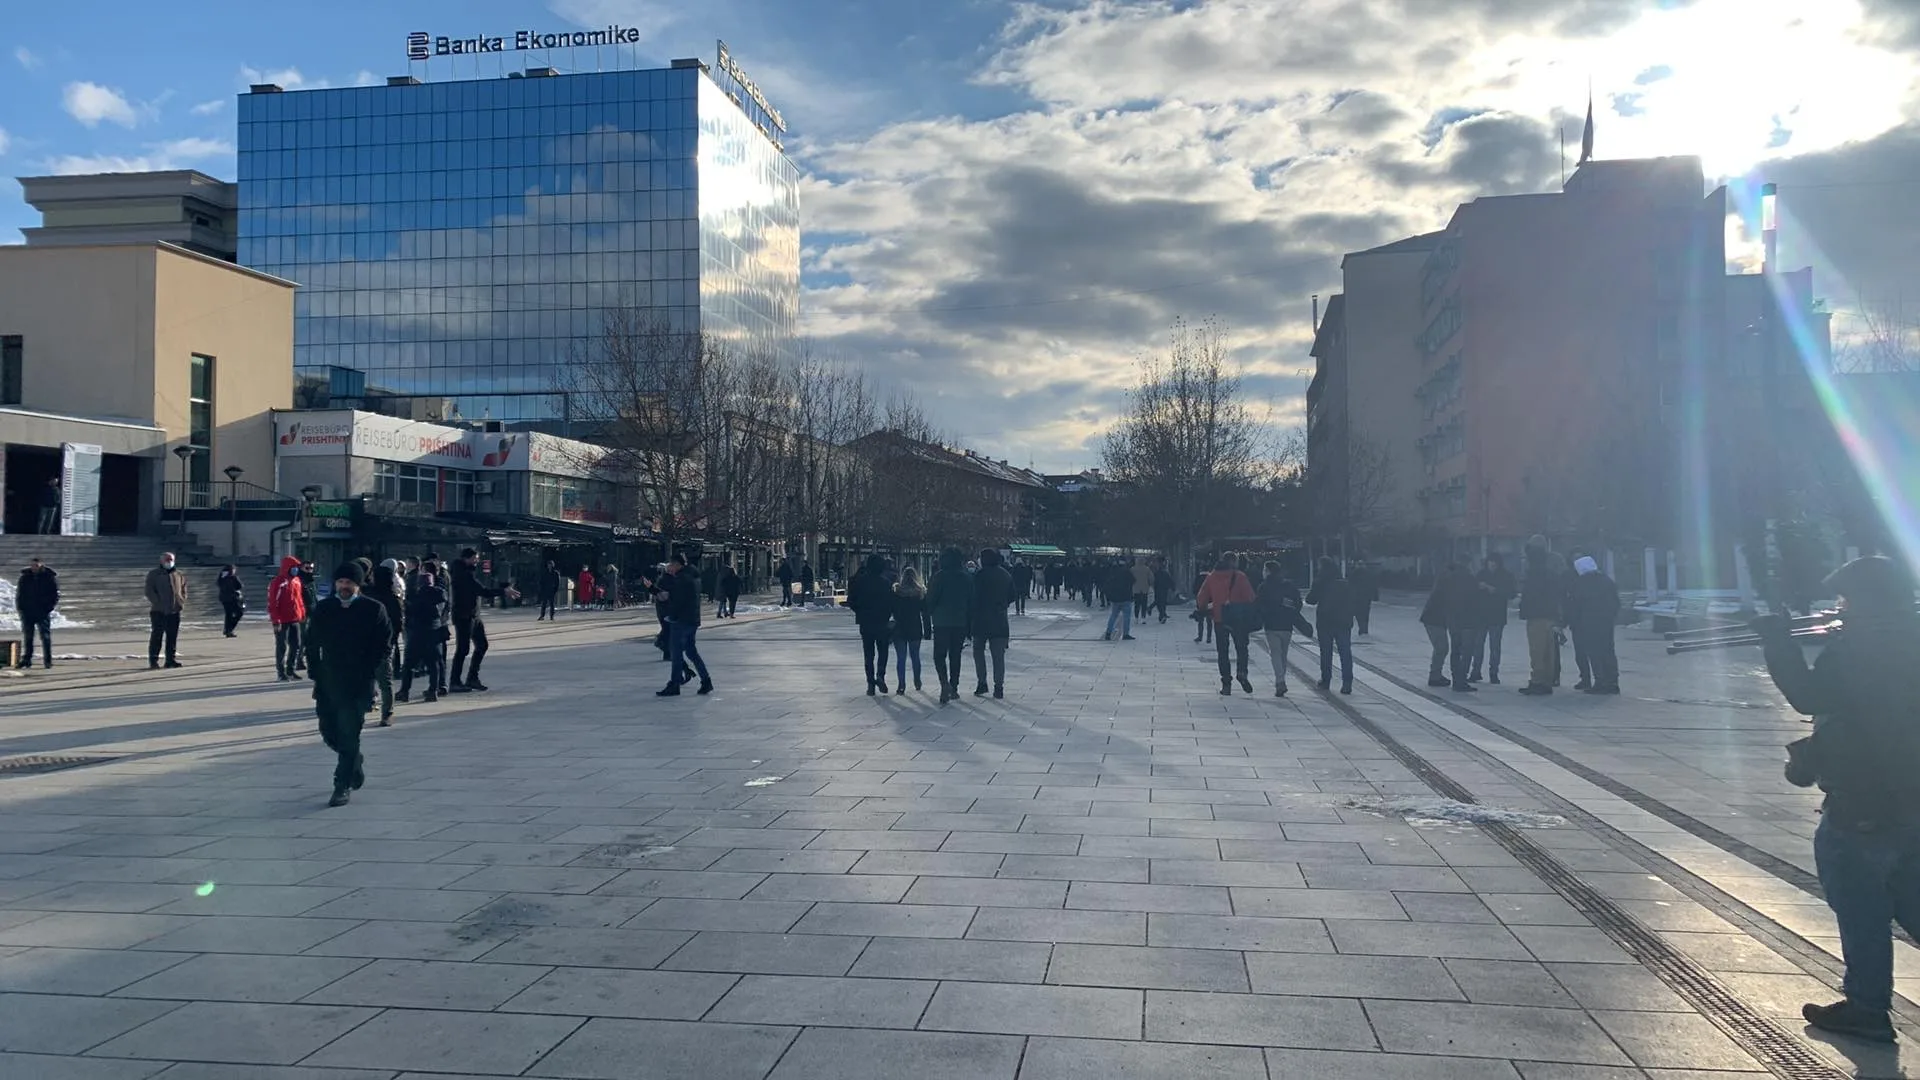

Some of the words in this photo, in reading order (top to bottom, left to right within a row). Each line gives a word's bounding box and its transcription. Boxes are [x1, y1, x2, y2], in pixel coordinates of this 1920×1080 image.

[435, 34, 504, 56] Banka
[515, 25, 640, 50] Ekonomike
[356, 426, 416, 451] REISEBÜRO
[419, 436, 472, 459] PRISHTINA
